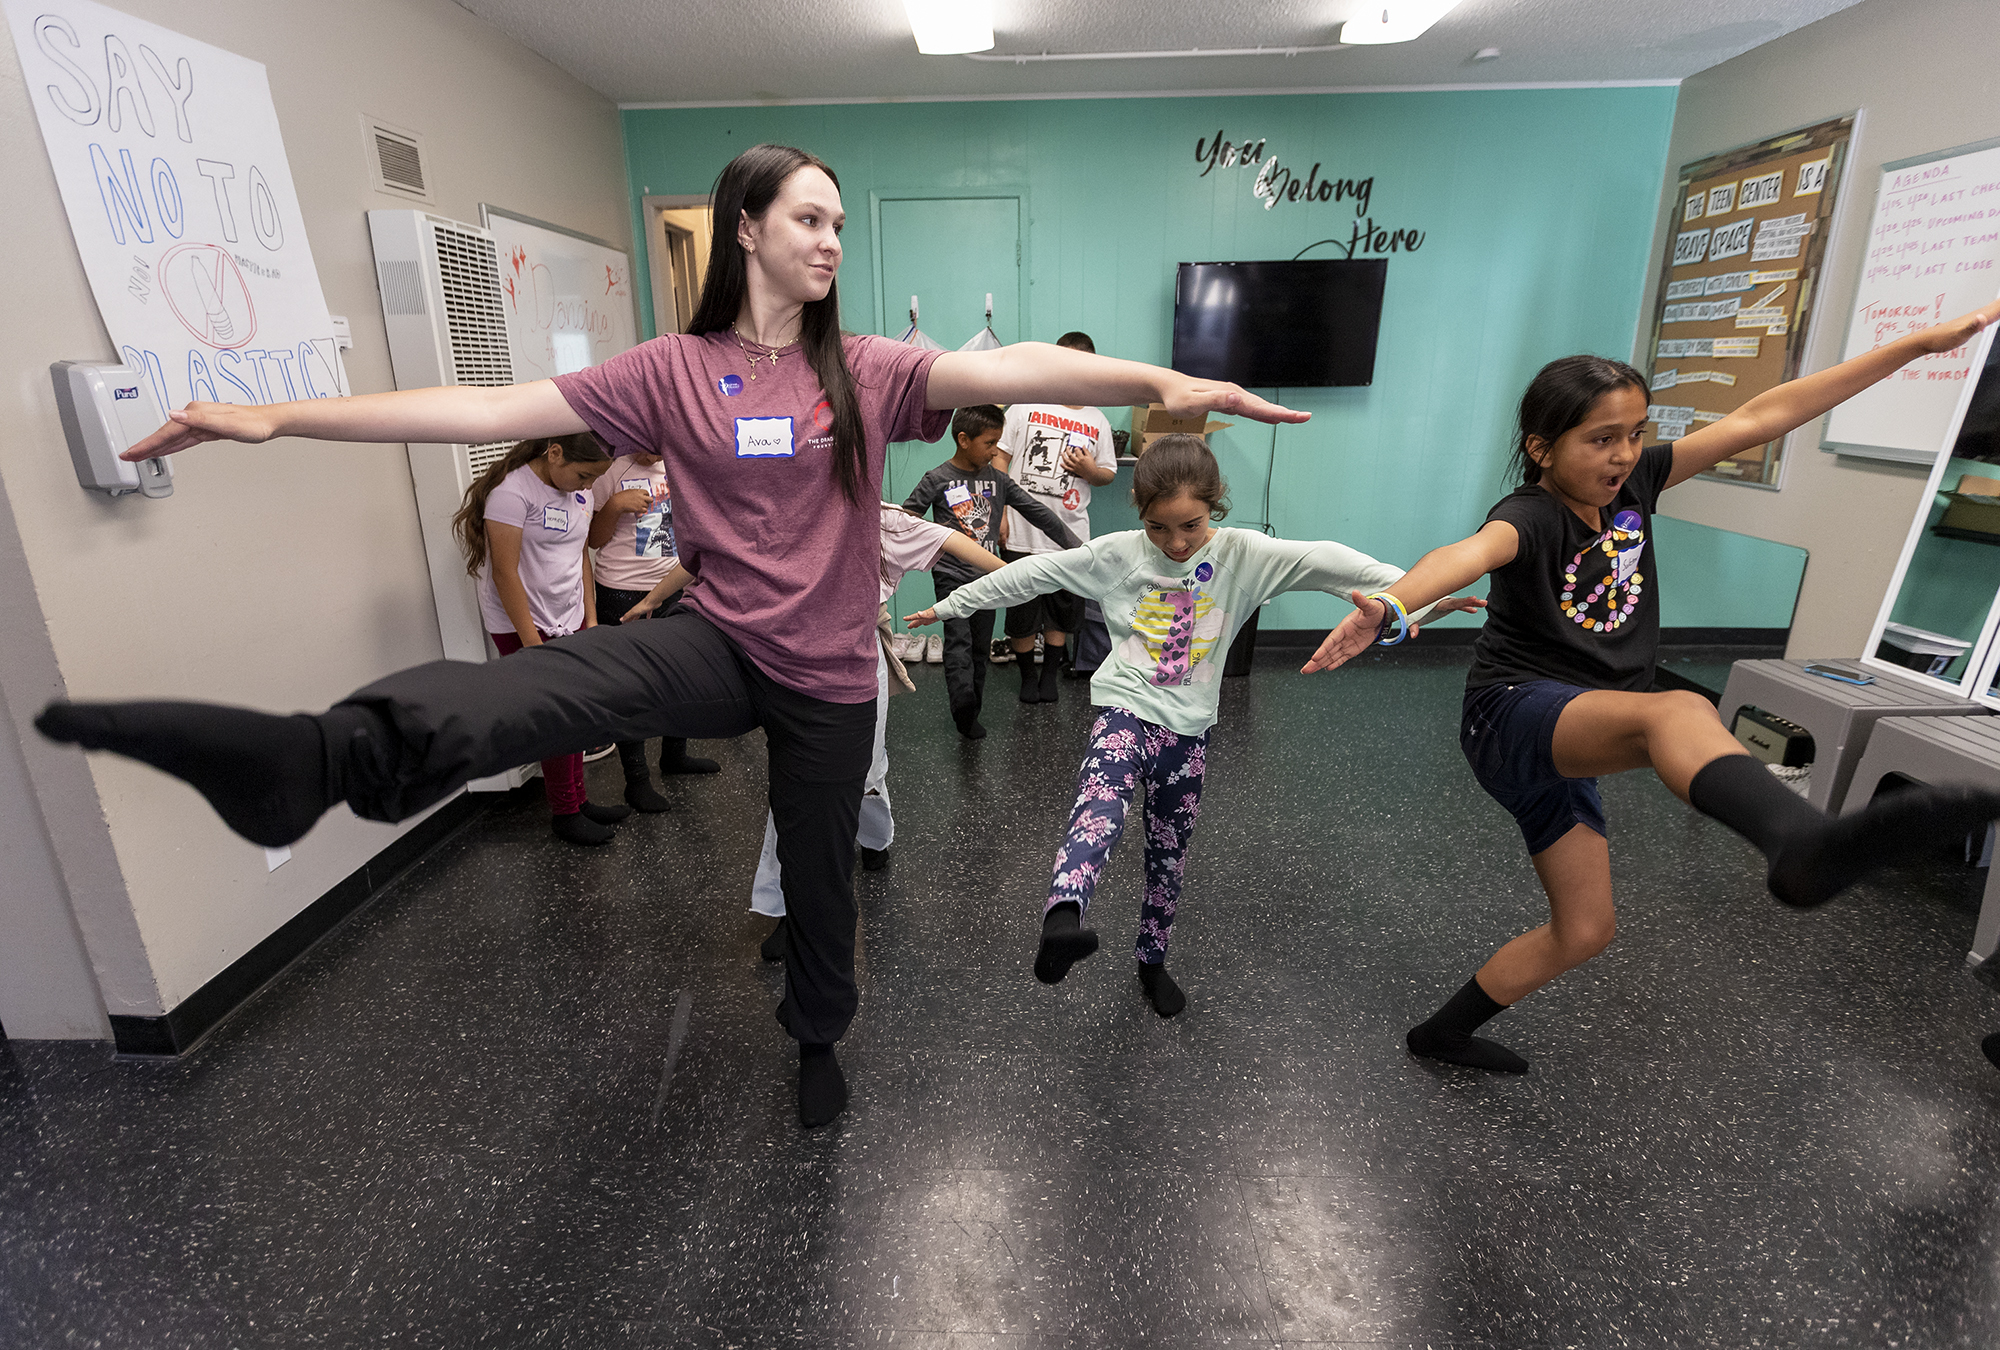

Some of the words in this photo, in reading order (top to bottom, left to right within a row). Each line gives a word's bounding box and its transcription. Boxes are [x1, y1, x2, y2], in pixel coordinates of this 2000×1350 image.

[35, 14, 192, 143] SAY
[1195, 130, 1266, 177] You
[1253, 155, 1374, 217] Belong
[1687, 196, 1704, 219] THE
[1710, 187, 1733, 212] TEEN
[1740, 176, 1780, 205] CENTER
[1798, 167, 1813, 191] IS
[1814, 164, 1825, 189] A
[1892, 164, 1949, 190] AGENDA
[89, 143, 184, 245] NO
[197, 158, 284, 251] TO
[1931, 188, 1965, 206] LAST
[1928, 209, 1984, 230] UPCOMING
[1293, 217, 1426, 260] Here
[1674, 233, 1708, 261] BRAVE
[1710, 223, 1751, 256] SPACE
[1921, 237, 1956, 255] LAST
[1962, 232, 1998, 247] TEAM
[1915, 262, 1947, 279] LAST
[1955, 259, 1994, 273] CLOSE
[1901, 369, 1921, 380] THE
[1027, 410, 1099, 441] AIRWALK
[747, 435, 772, 448] Ava
